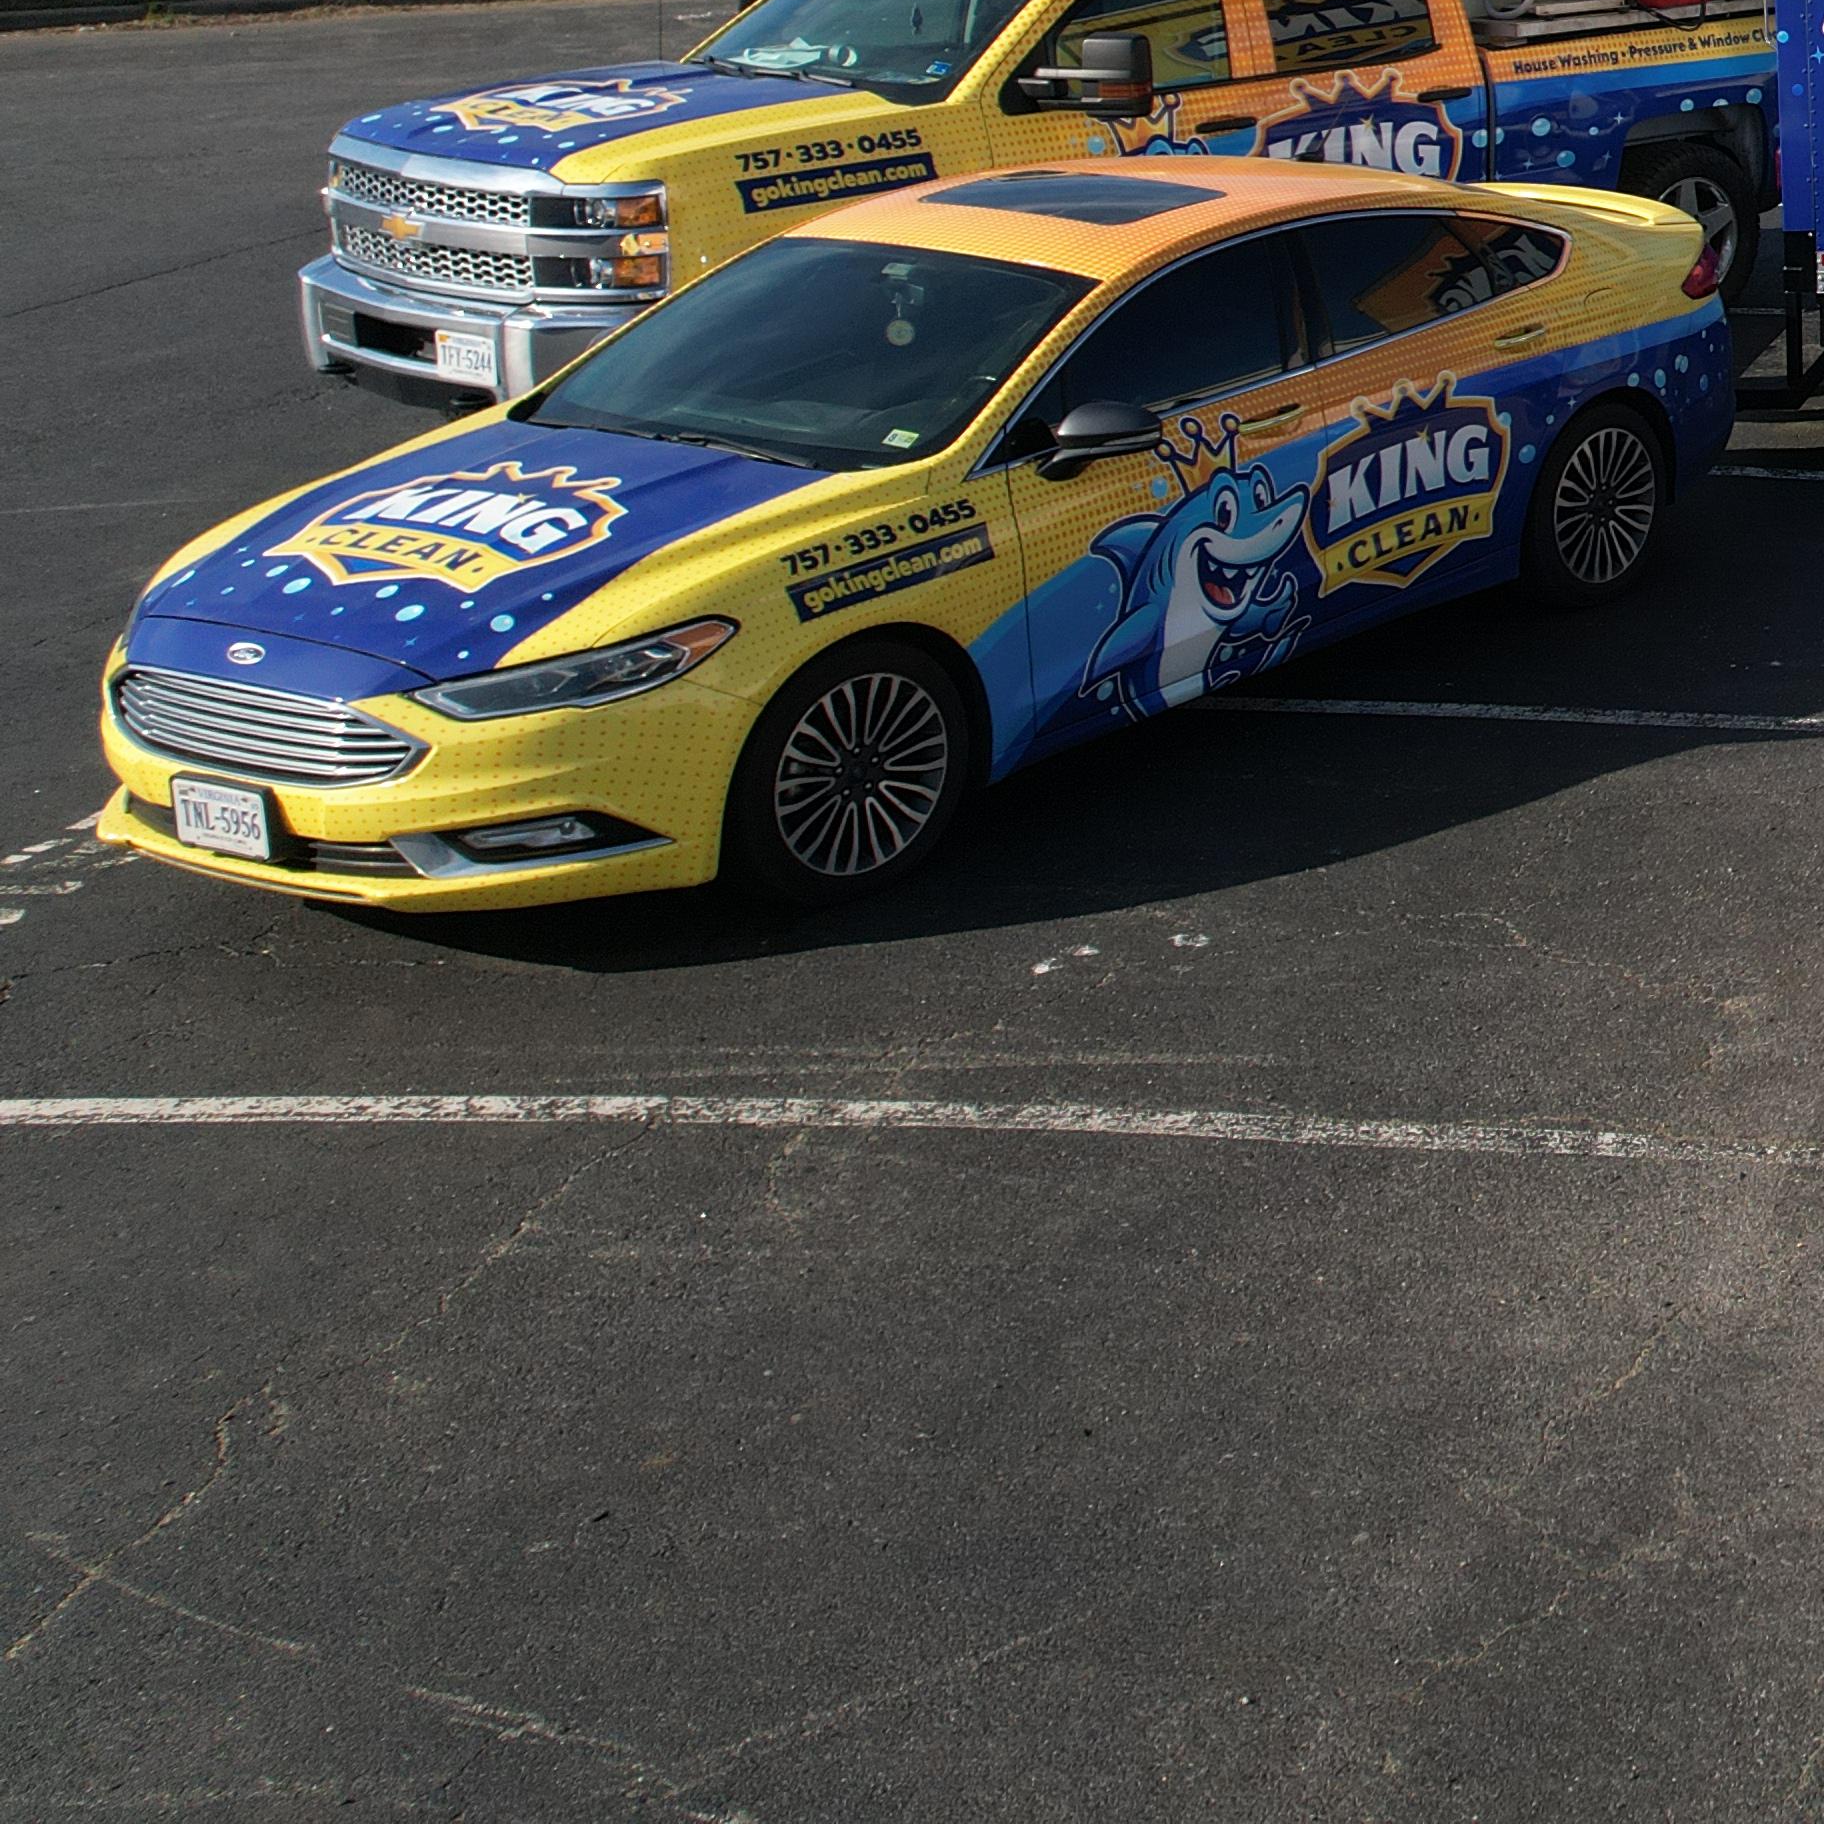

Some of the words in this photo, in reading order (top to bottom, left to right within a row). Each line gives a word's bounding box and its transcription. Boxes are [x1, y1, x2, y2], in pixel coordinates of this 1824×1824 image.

[1514, 60, 1556, 74] House
[1560, 49, 1619, 68] Washing
[1629, 40, 1686, 58] Pressure
[1688, 37, 1698, 50] &
[1699, 31, 1750, 49] Window
[751, 162, 927, 207] gokingclean.com
[1328, 424, 1490, 535] KING
[342, 486, 589, 555] KING
[1347, 505, 1470, 569] CLEAN
[318, 528, 484, 573] CLEAN
[803, 536, 983, 613] gokingclean.com
[181, 799, 261, 840] TNL-5956
